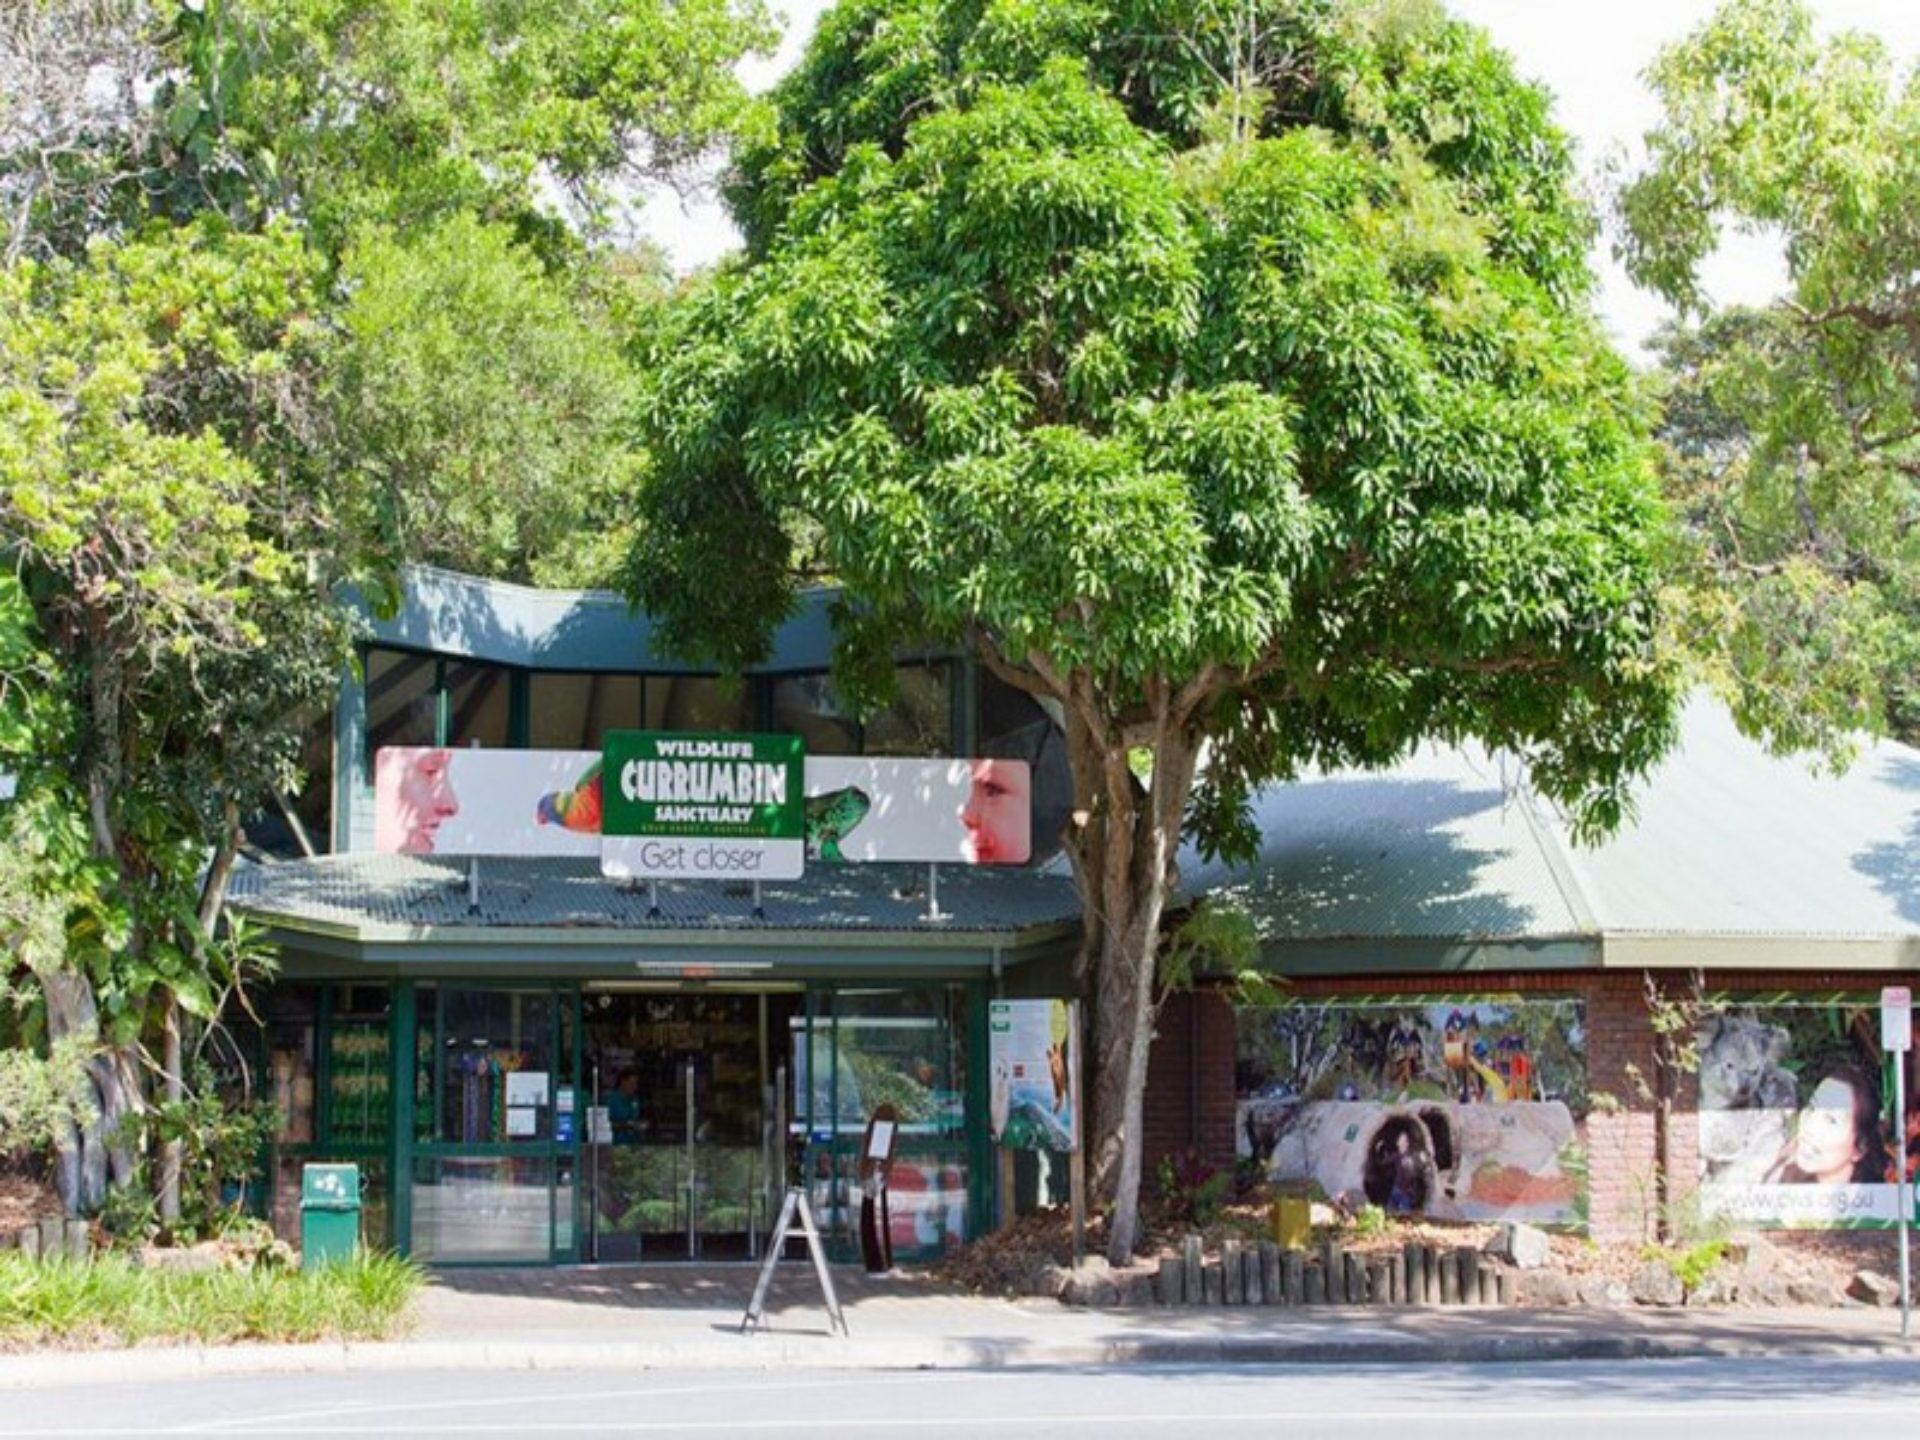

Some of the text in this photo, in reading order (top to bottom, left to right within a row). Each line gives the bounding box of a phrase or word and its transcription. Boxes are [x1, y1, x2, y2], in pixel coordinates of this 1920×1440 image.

[656, 740, 754, 758] WILDLIFE
[620, 759, 787, 805] CURRUMBIN
[655, 805, 754, 823] SANCTUARY
[640, 841, 765, 872] Get closer
